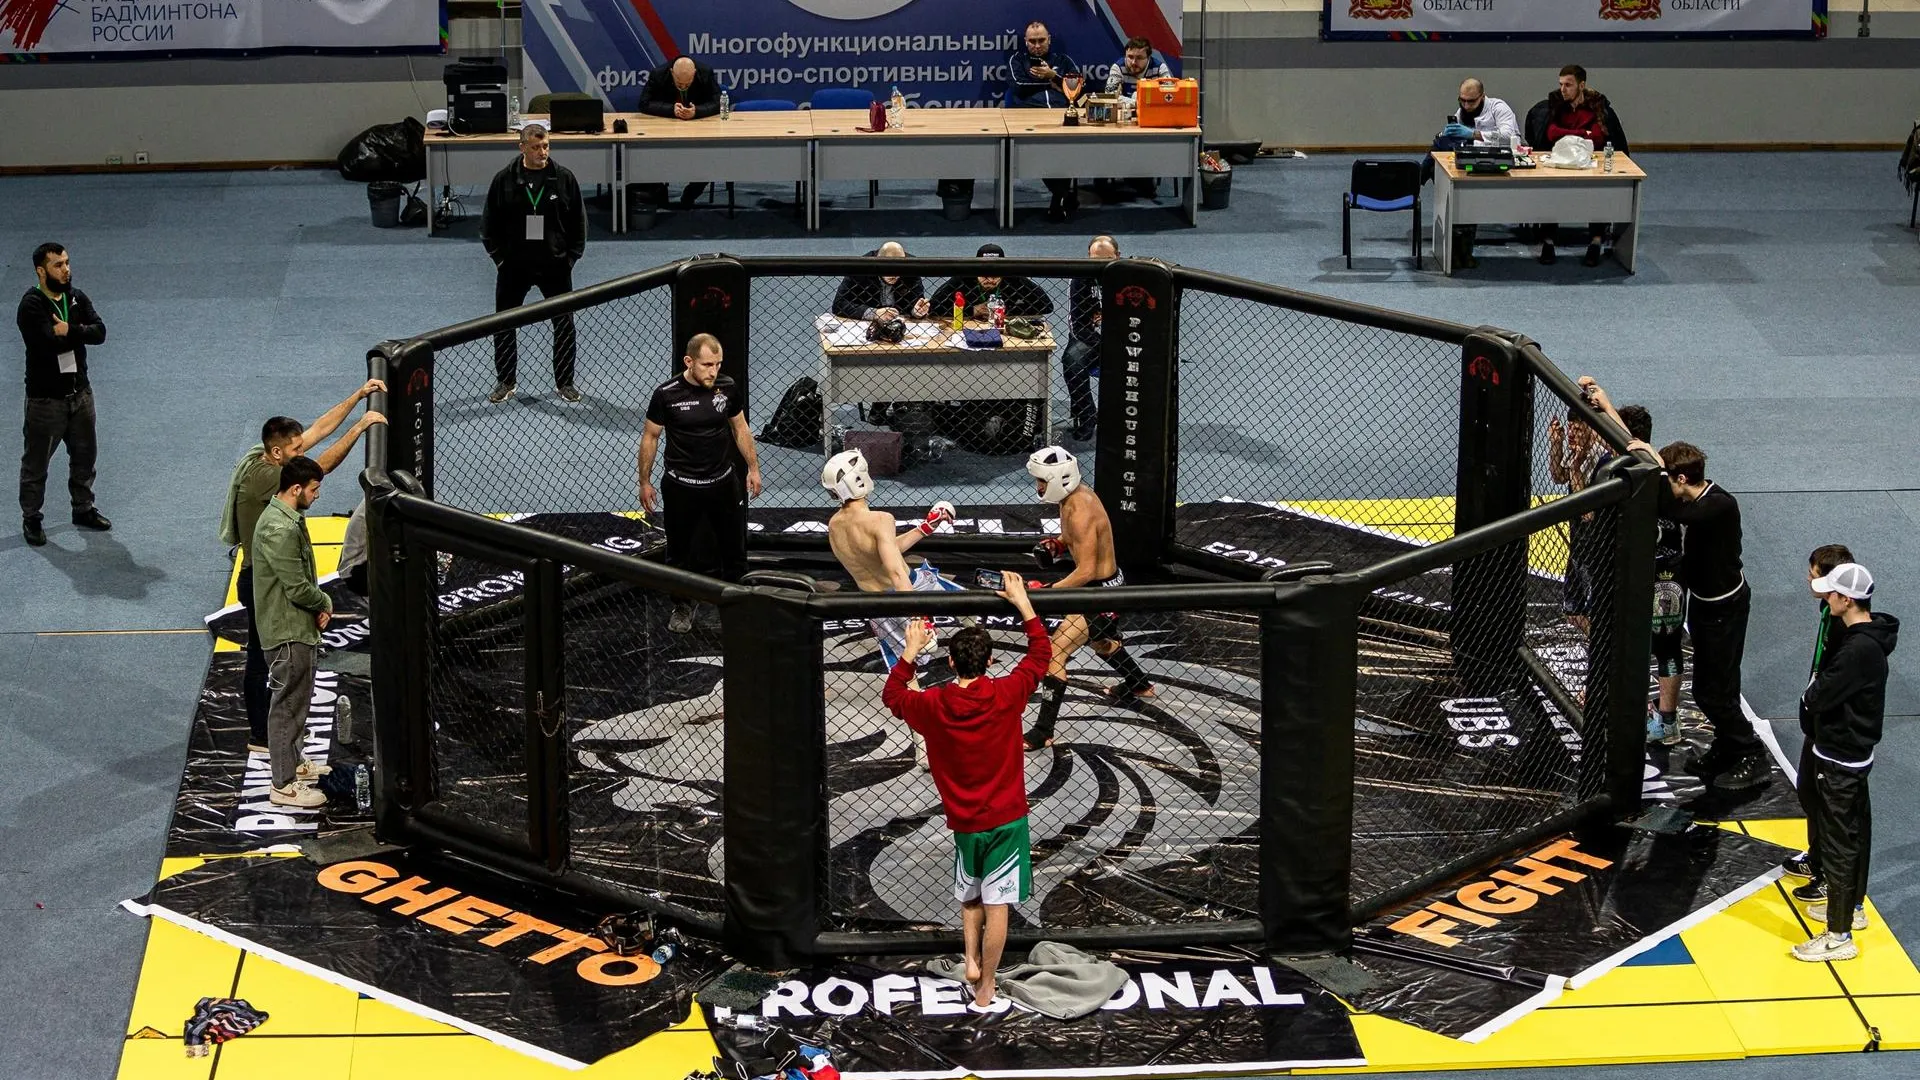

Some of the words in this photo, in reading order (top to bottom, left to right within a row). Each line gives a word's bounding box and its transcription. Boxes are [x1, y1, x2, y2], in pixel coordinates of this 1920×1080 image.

[92, 3, 238, 25] БАДМИНТОНА
[92, 24, 174, 42] РОССИИ
[688, 29, 1018, 58] Многофункциональный
[597, 60, 973, 92] физтурно-спортивный
[1124, 316, 1142, 460] POWERHOUSE
[1439, 697, 1520, 748] UBS
[1386, 838, 1615, 948] FIGHT
[317, 861, 662, 986] GHETTO
